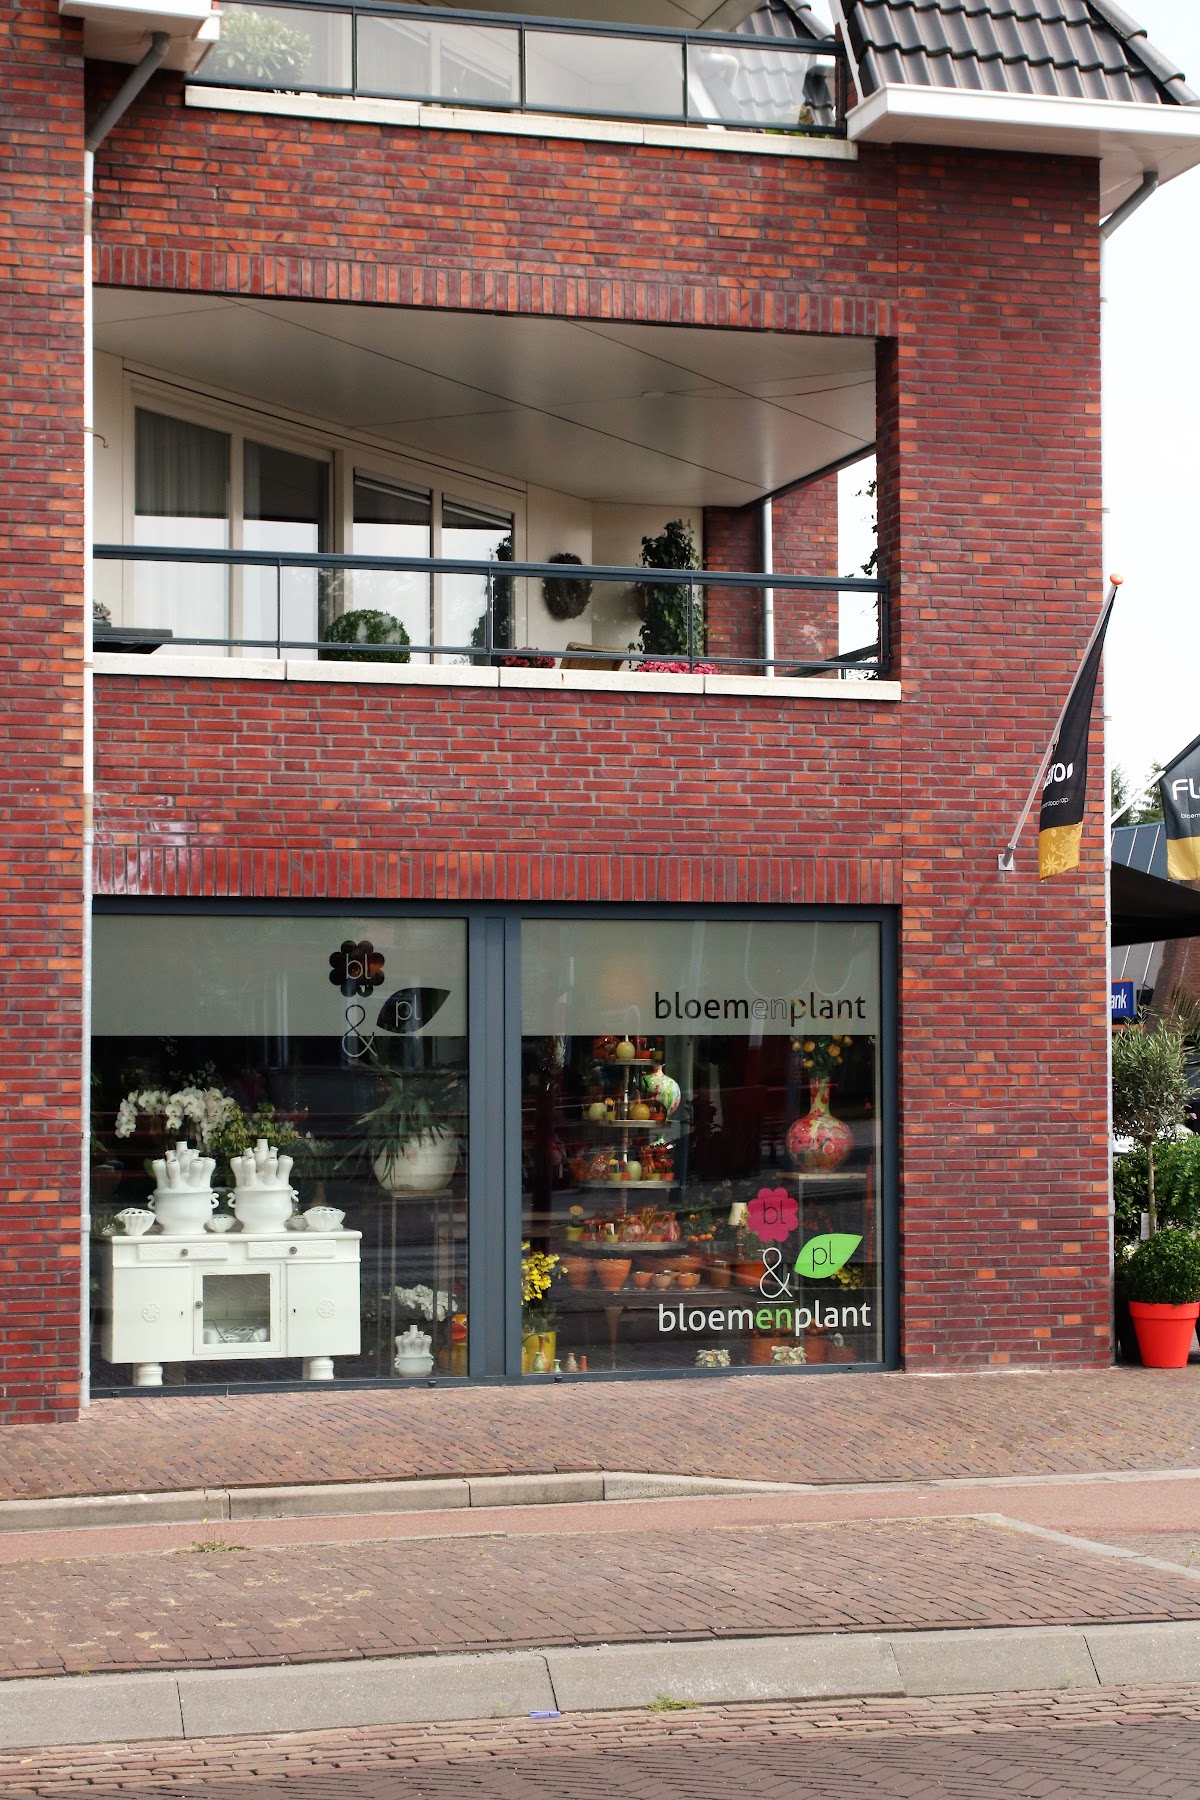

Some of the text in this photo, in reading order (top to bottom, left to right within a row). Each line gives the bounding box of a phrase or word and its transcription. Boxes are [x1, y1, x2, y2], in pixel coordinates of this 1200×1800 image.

[345, 953, 371, 980] bl
[341, 994, 421, 1058] & pl
[655, 991, 866, 1027] bloemenplant
[762, 1200, 786, 1225] bl
[759, 1240, 836, 1299] & pl
[658, 1299, 872, 1337] bloemenplant
